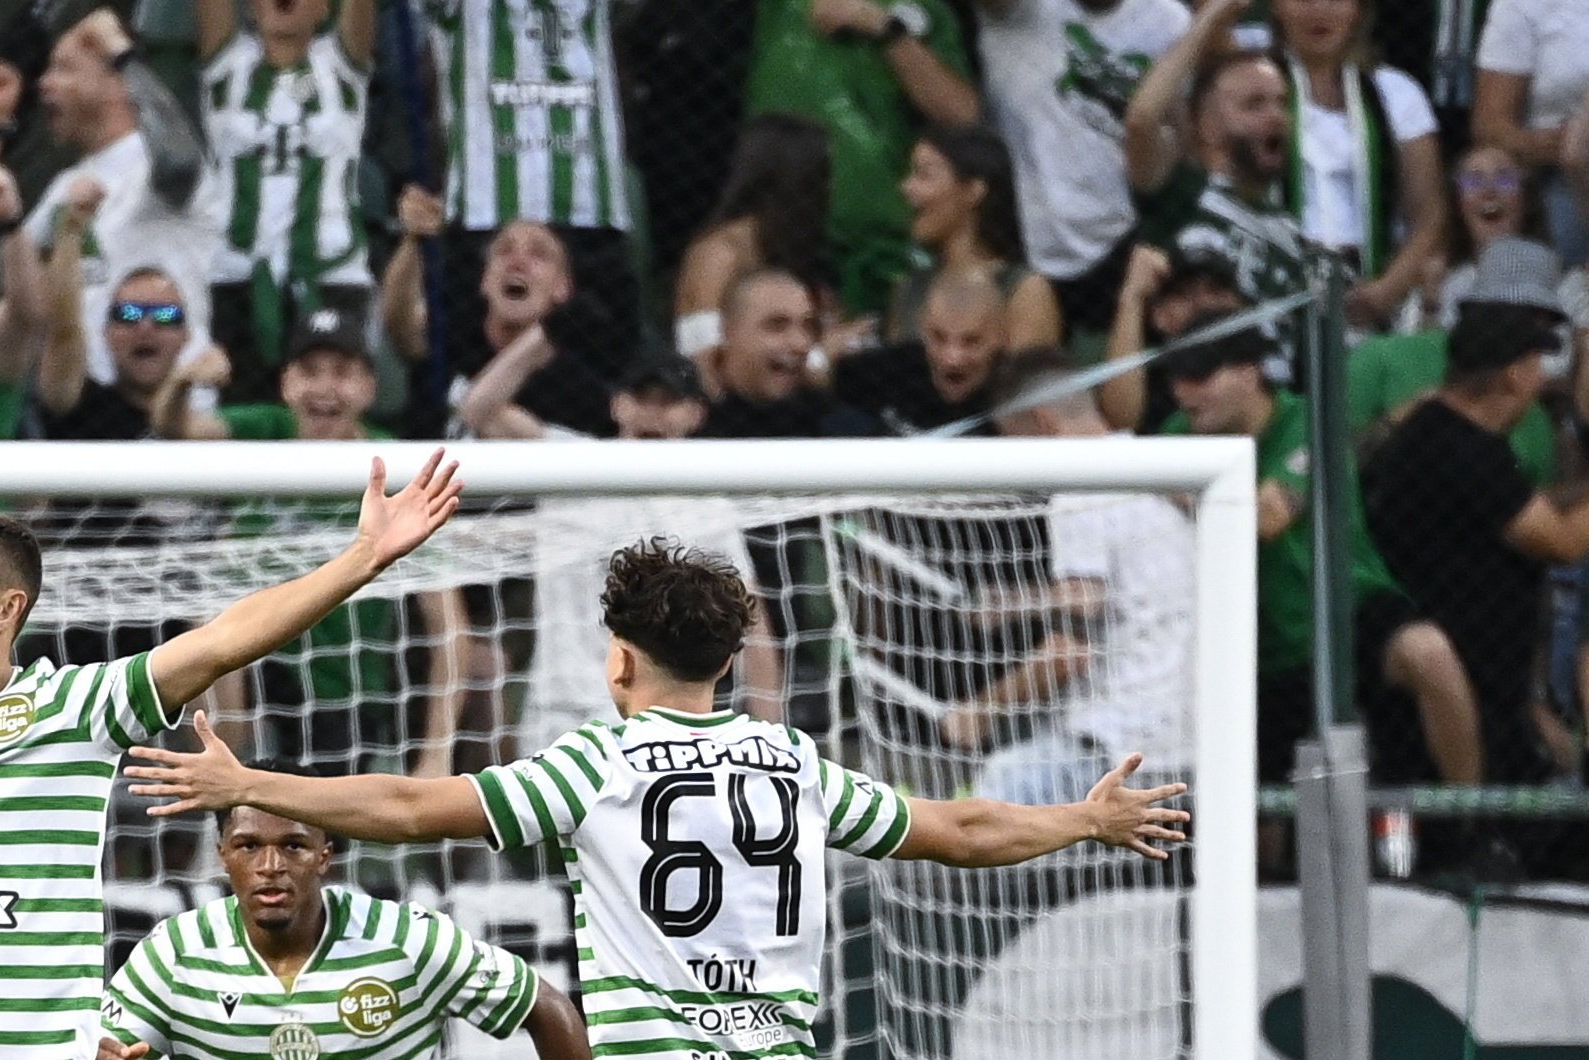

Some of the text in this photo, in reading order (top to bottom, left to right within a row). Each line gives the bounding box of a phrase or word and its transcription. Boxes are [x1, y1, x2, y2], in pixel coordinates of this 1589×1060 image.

[639, 772, 802, 938] 64
[360, 993, 391, 1009] fizz
[362, 1009, 393, 1026] liga
